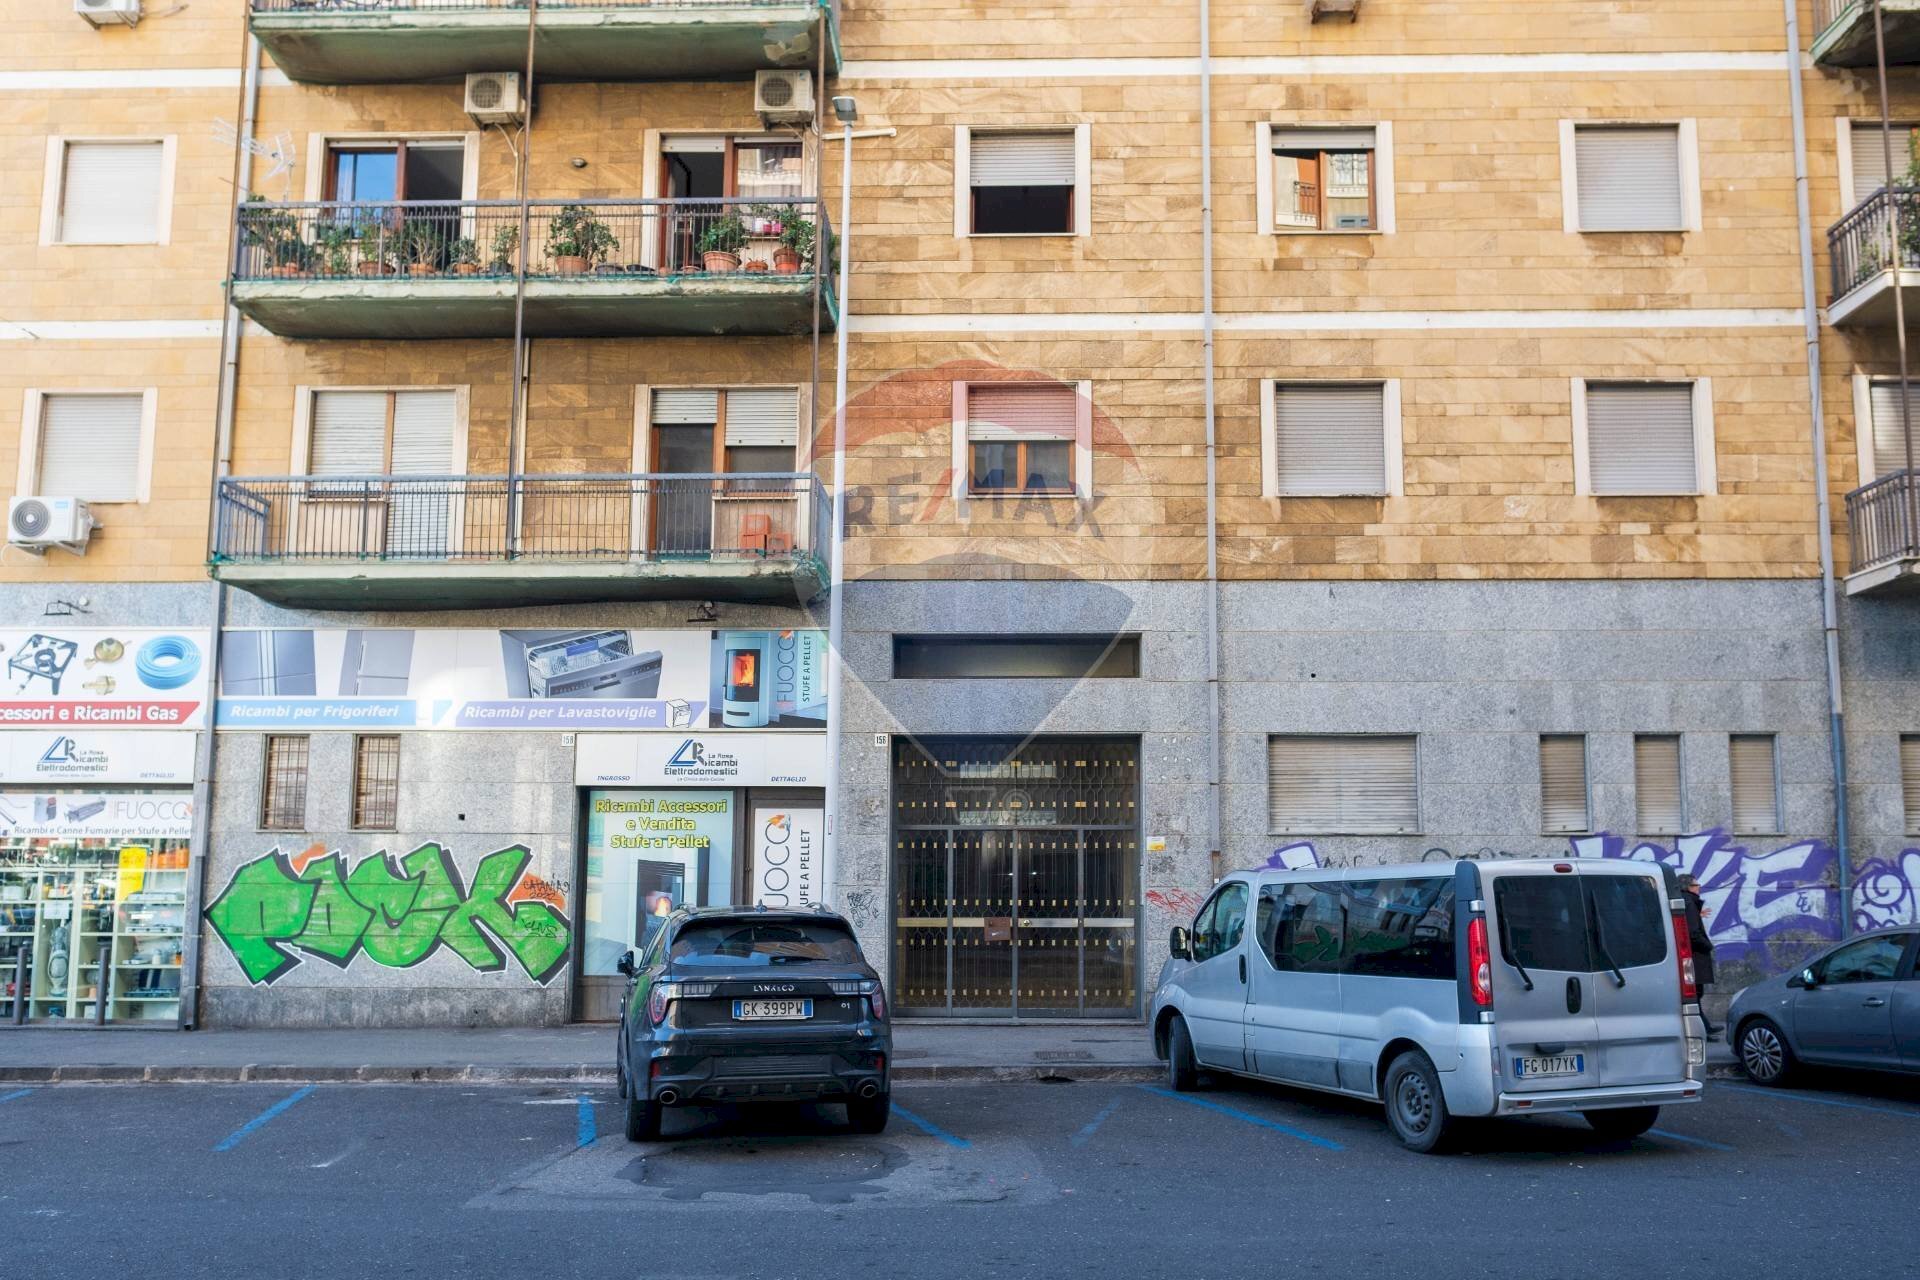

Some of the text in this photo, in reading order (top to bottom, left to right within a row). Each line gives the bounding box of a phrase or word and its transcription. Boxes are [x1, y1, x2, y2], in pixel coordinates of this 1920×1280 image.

[803, 636, 811, 665] PELLET
[802, 676, 811, 702] STUFE
[59, 709, 69, 720] e
[74, 705, 141, 720] Ricambi
[147, 705, 178, 720] Gas
[230, 705, 399, 719] Ricambi per Frigoriferi
[465, 706, 657, 720] Ricambi per Lavastoviglie
[36, 764, 109, 772] Elettrodomestici
[664, 767, 738, 775] Elettrodomestici
[595, 799, 727, 813] Ricambi Accessori
[626, 817, 696, 830] e Vendita
[14, 826, 48, 834] Ricambi
[56, 826, 82, 834] Canne
[84, 826, 119, 834] Fumarie
[121, 828, 136, 836] per
[138, 826, 160, 835] Stufe
[169, 826, 190, 835] Pelle
[611, 834, 710, 848] Stufe a Pellet
[800, 829, 810, 870] PELLET
[800, 873, 809, 881] A
[743, 1002, 803, 1015] GK 399PW
[1523, 1056, 1577, 1073] FG 017YK
